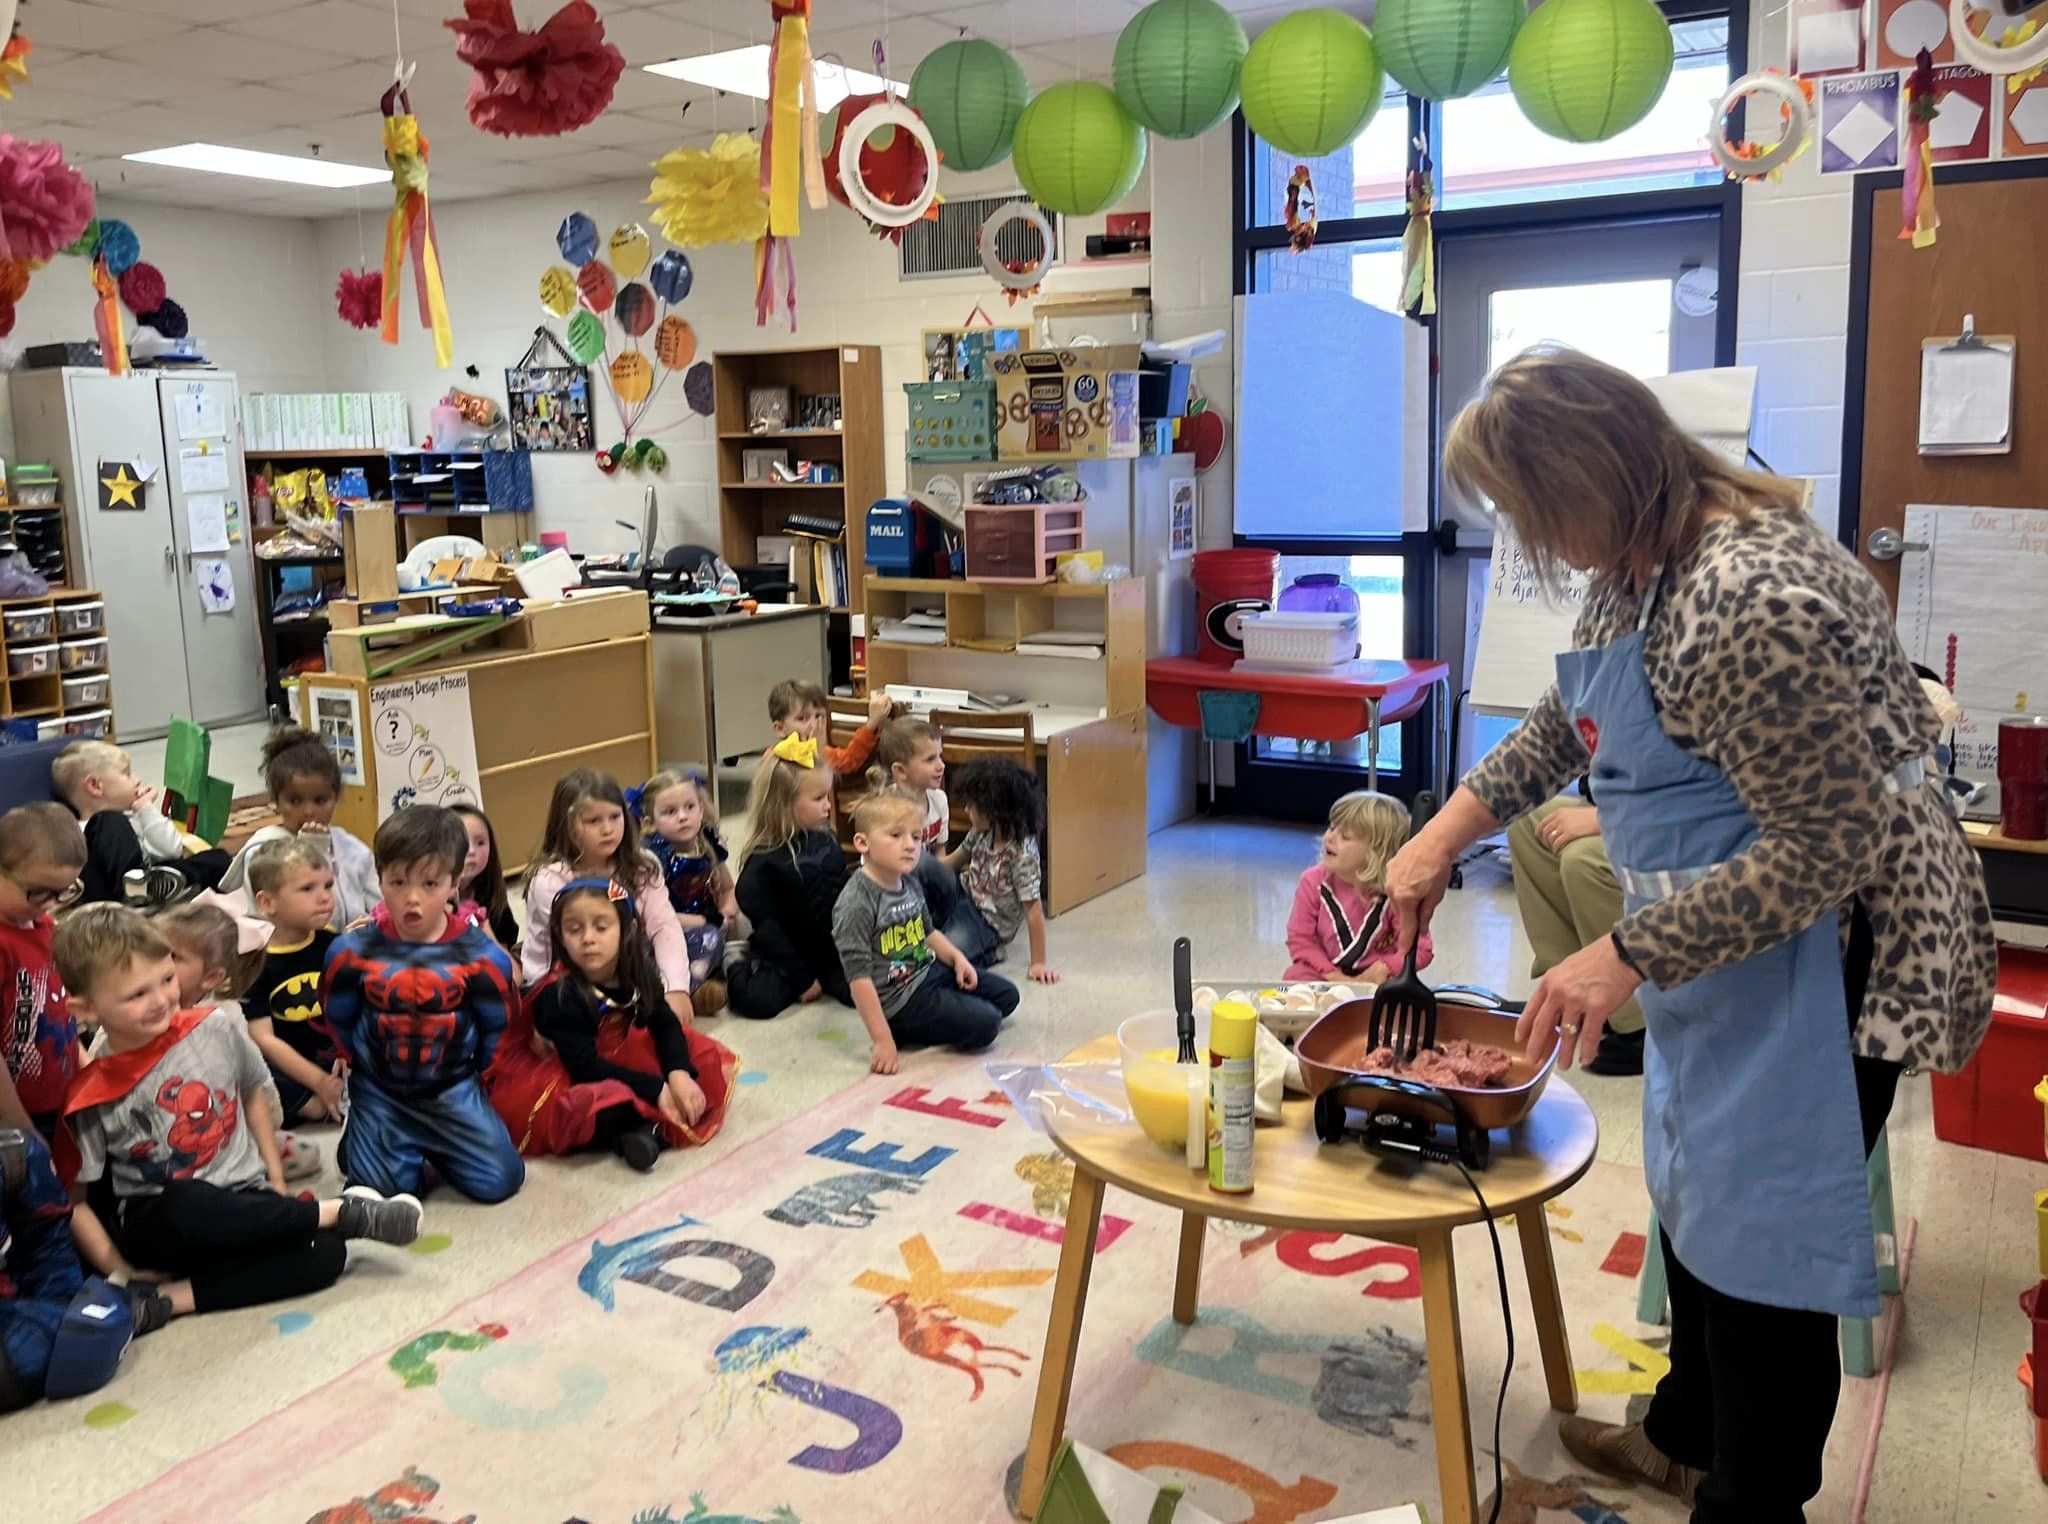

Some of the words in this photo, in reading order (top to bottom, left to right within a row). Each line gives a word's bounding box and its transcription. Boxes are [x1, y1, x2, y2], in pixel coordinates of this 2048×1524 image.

[1826, 75, 1896, 96] RHOMBUS
[1932, 66, 1984, 82] NTAGO
[1079, 376, 1095, 390] 60
[870, 525, 904, 537] MAIL
[1499, 563, 1506, 578] 3
[1494, 581, 1503, 597] 4
[370, 684, 414, 706] Engineering
[415, 680, 439, 699] Design
[440, 675, 467, 690] Process
[883, 1087, 1006, 1128] F
[805, 1128, 959, 1177] E
[618, 1237, 776, 1313] D
[850, 1232, 1057, 1327] K
[1275, 1231, 1422, 1300] S
[439, 1344, 608, 1431] C
[759, 1368, 903, 1475] J
